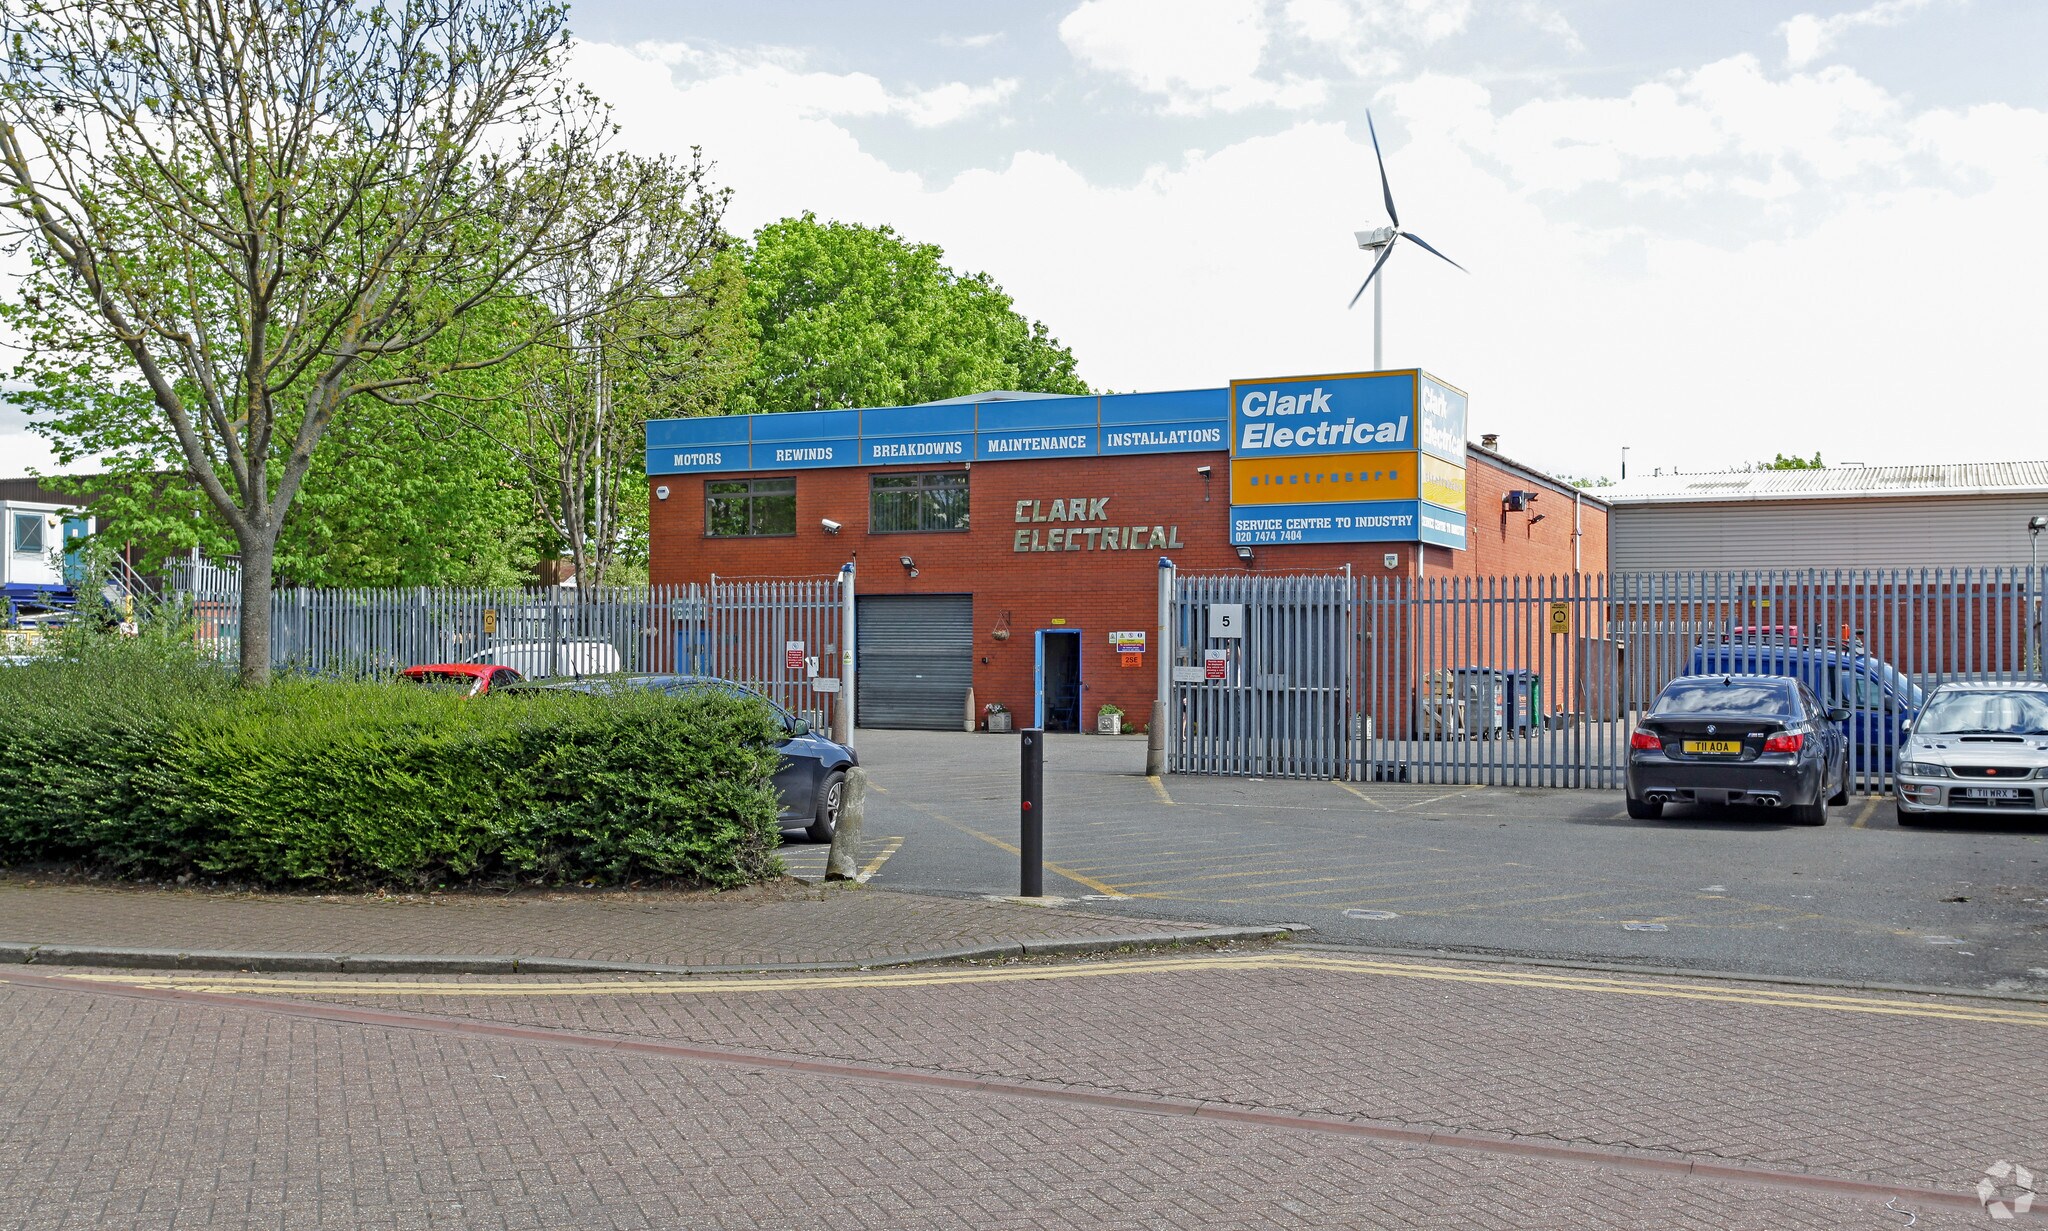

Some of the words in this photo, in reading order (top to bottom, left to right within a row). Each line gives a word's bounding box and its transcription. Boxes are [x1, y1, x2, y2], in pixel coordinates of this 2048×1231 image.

[1241, 387, 1333, 418] Clark
[1107, 428, 1221, 447] INSTALLATIONS
[1241, 415, 1409, 449] Electrical
[872, 440, 963, 458] BREAKDOWNS
[988, 435, 1087, 453] MAINTENANCE
[673, 452, 722, 466] MOTORS
[775, 447, 833, 462] REWINDS
[1250, 469, 1398, 486] electrocare
[1014, 497, 1111, 523] CLARK
[1235, 519, 1283, 531] SERVICE
[1285, 517, 1332, 530] CENTRE
[1335, 517, 1351, 529] TO
[1354, 515, 1413, 528] INDUSTRY
[1013, 525, 1185, 552] ELECTRICAL
[1235, 531, 1252, 542] 020
[1255, 531, 1276, 542] 7474
[1280, 530, 1302, 541] 7404
[1222, 615, 1230, 627] 5
[1990, 789, 2008, 797] WRX
